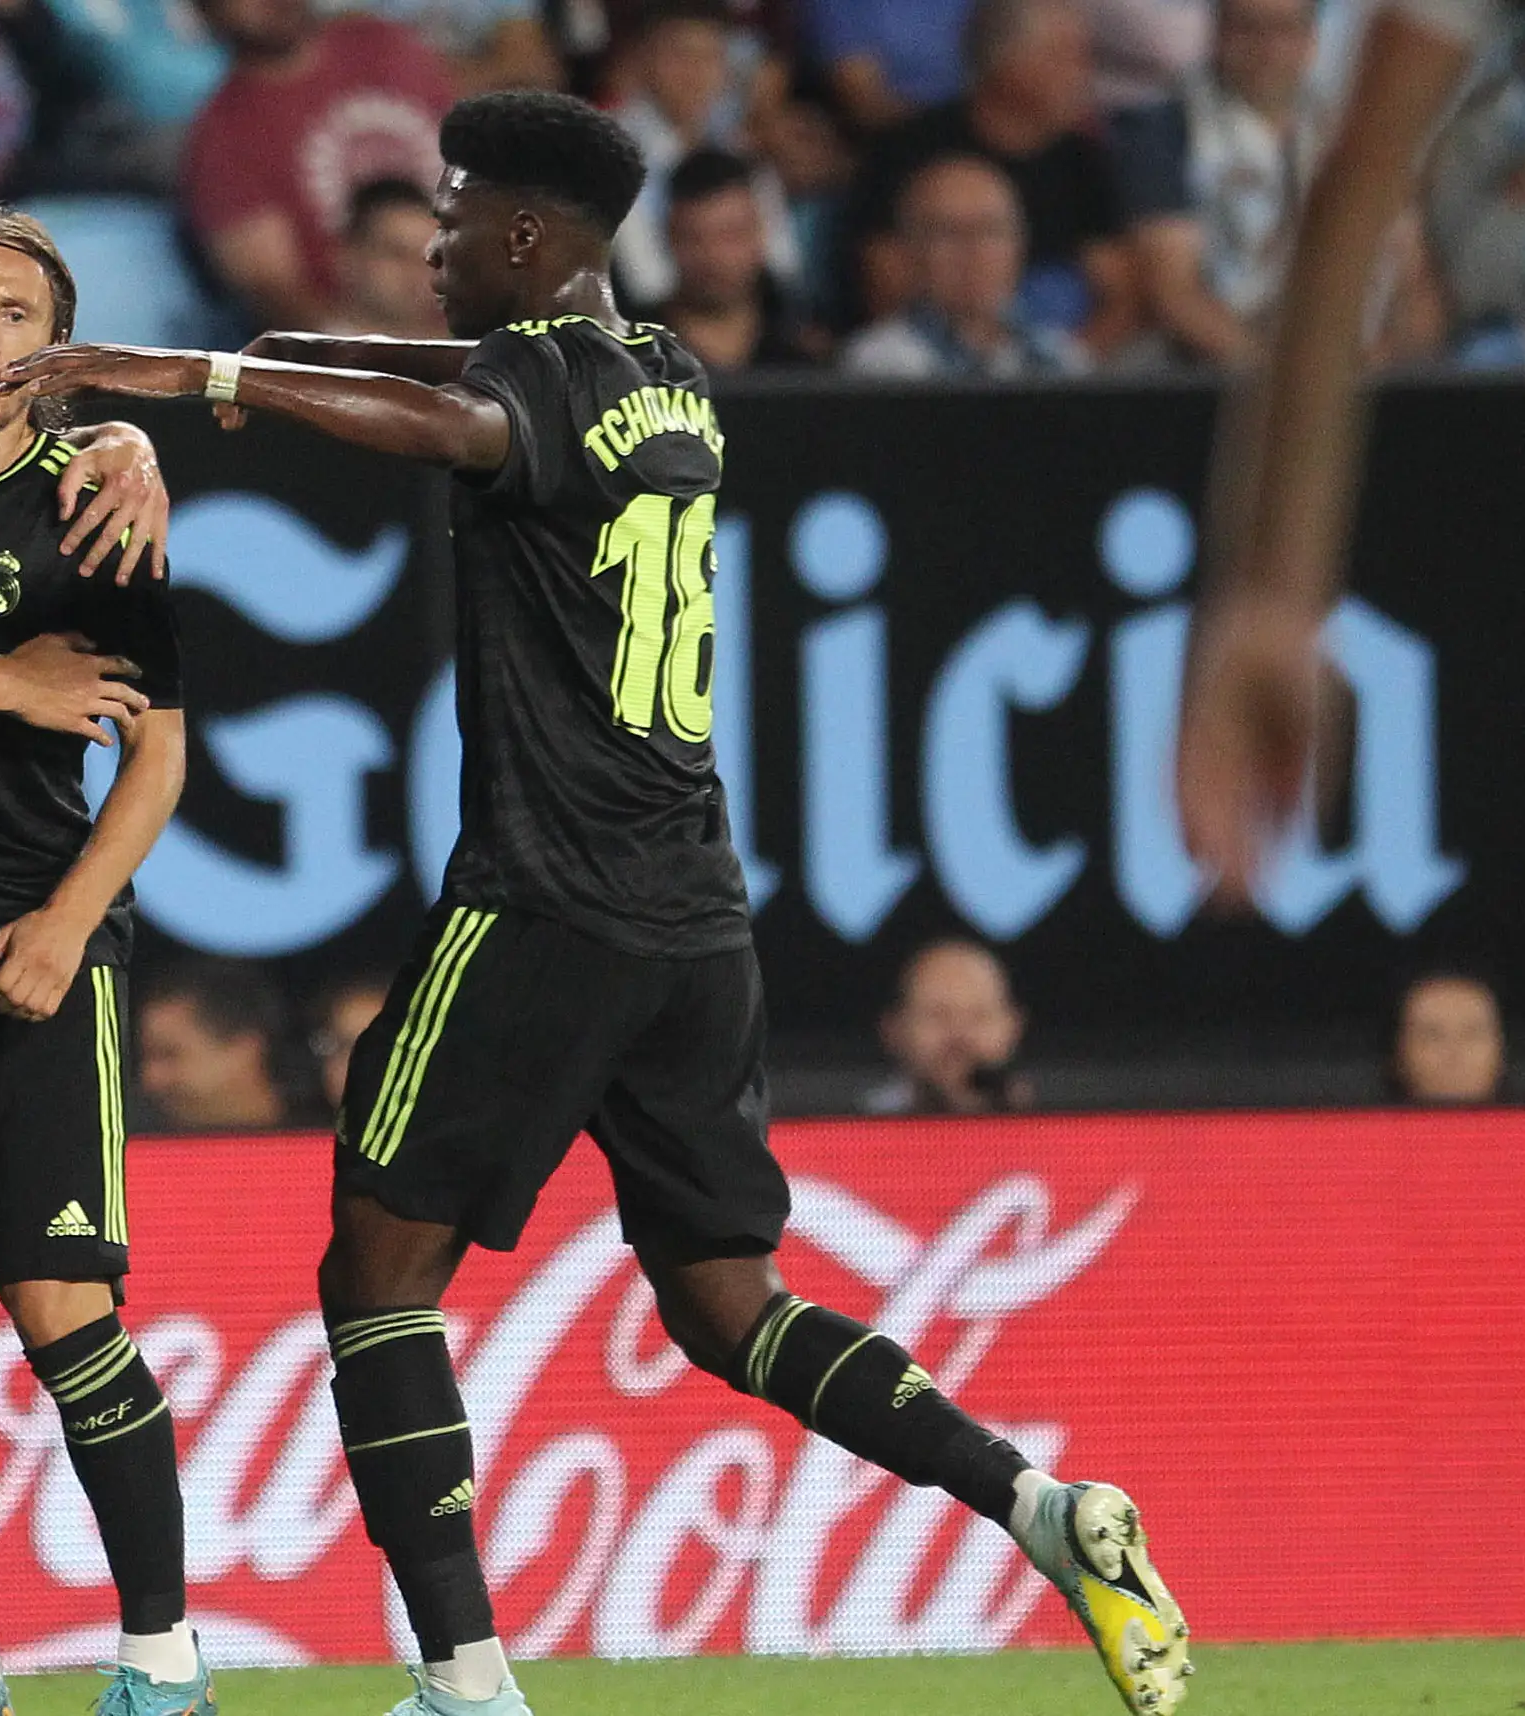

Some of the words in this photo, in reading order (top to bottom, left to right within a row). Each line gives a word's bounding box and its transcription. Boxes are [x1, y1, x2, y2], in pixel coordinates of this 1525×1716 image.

[585, 386, 726, 472] TCHOUAM
[77, 488, 1466, 957] Glicia
[46, 1224, 97, 1237] adidas
[70, 1397, 134, 1432] MCF
